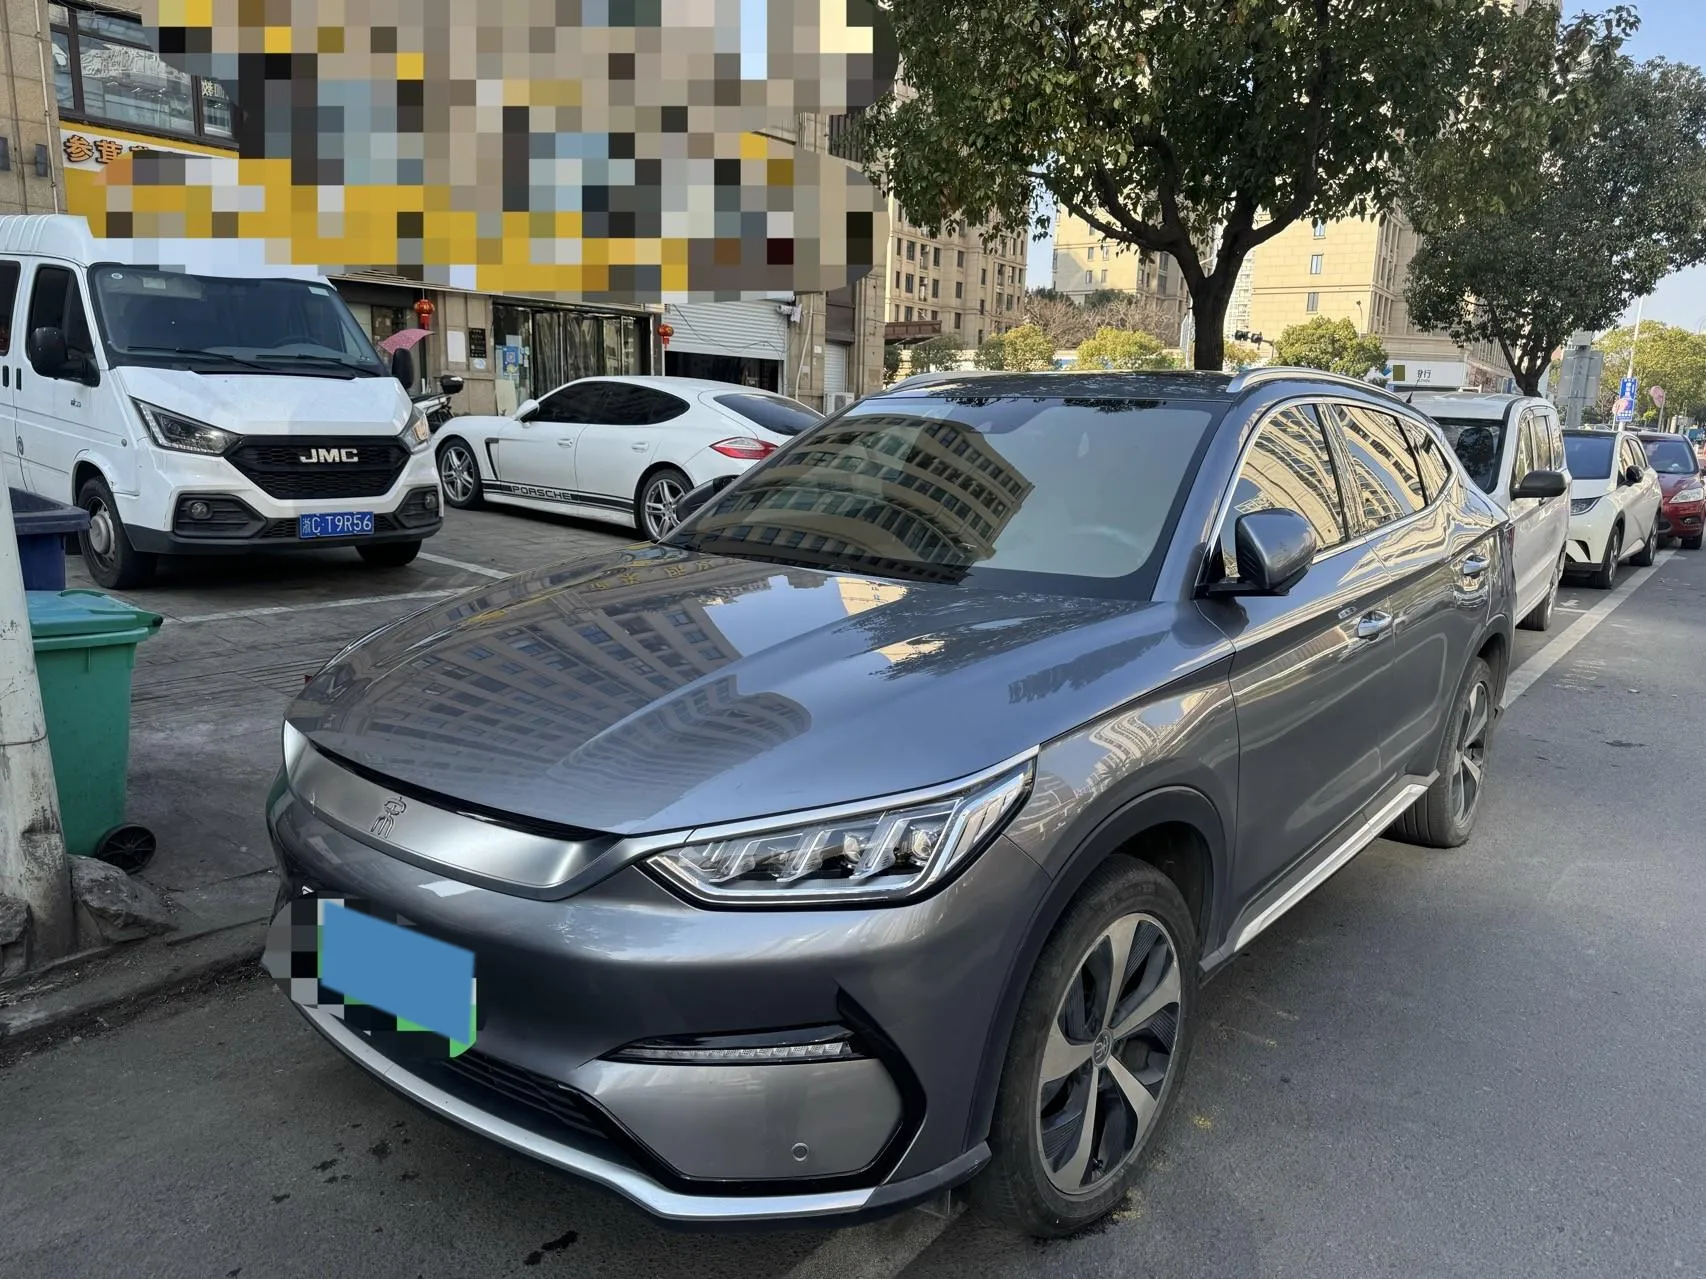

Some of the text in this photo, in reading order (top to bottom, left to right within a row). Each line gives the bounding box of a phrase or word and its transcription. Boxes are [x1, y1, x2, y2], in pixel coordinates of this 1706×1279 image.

[63, 134, 149, 165] 参茸
[300, 448, 359, 463] JMC
[512, 485, 572, 501] PORSCHE
